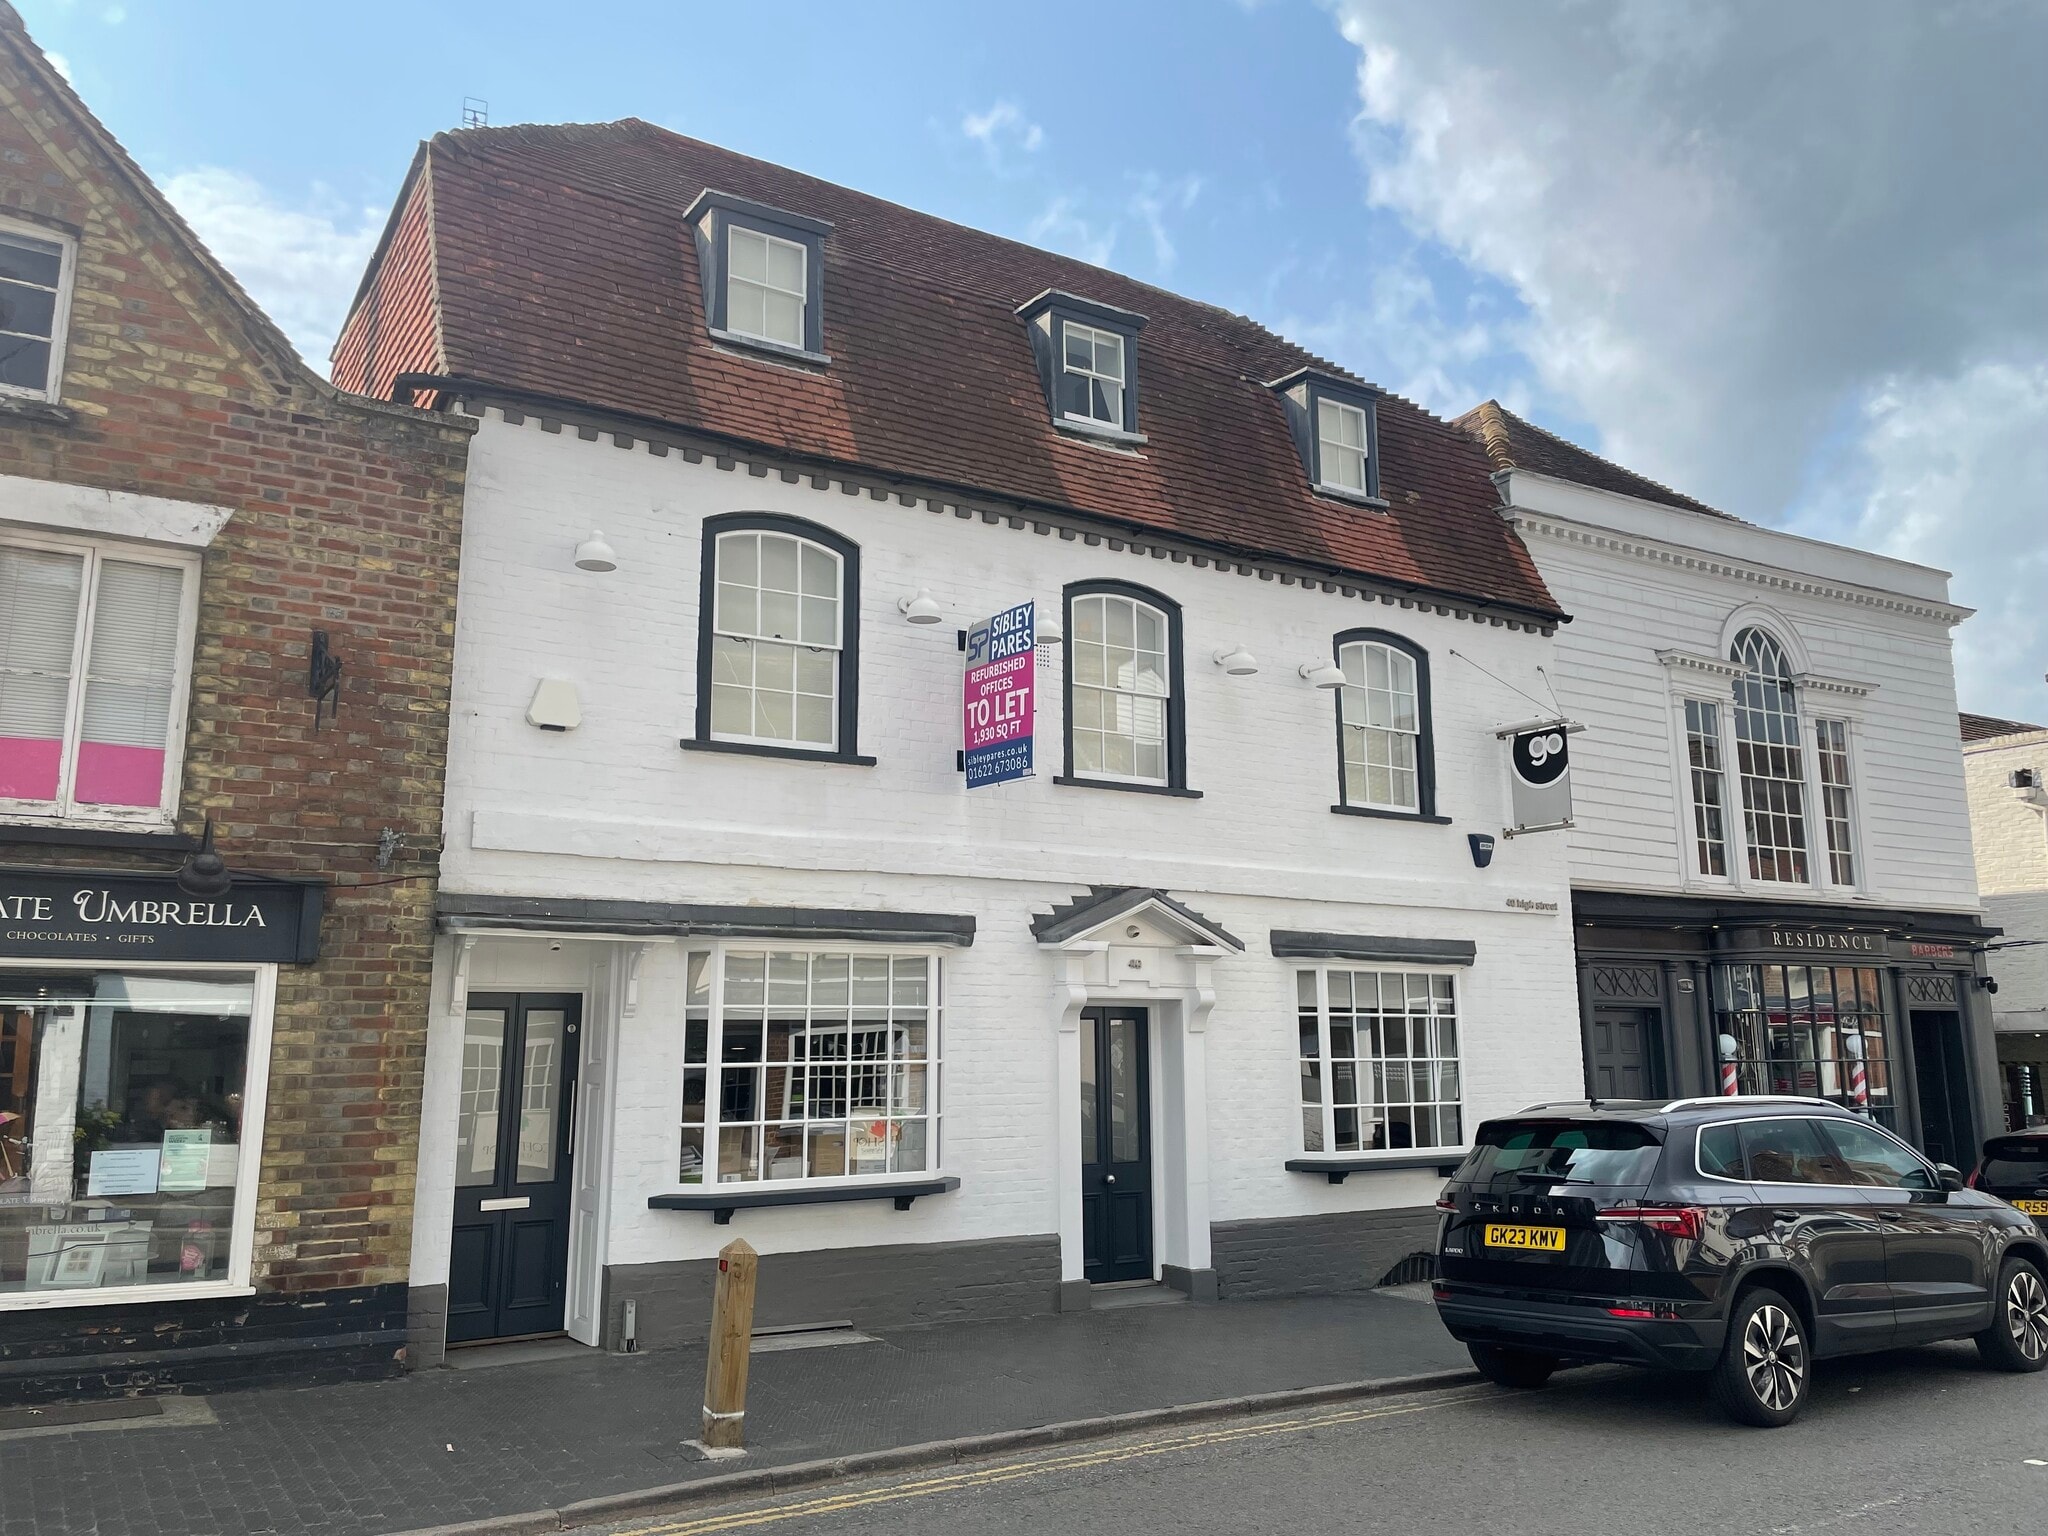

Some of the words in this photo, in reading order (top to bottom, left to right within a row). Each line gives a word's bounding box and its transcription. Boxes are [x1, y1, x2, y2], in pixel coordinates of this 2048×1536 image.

[992, 604, 1033, 637] SIBLEY
[991, 629, 1031, 660] PARES
[971, 656, 1026, 684] REFURBISHED
[980, 676, 1013, 696] OFFICES
[967, 698, 990, 729] TO
[995, 688, 1029, 722] LET
[973, 726, 995, 745] 1,930
[996, 723, 1008, 739] SQ
[1010, 720, 1021, 735] FT
[967, 743, 1028, 766] sibleypares.co.uk
[1528, 733, 1564, 767] go
[968, 763, 993, 780] 01622
[994, 756, 1028, 774] 673086
[73, 889, 266, 928] UMBRELLA
[6, 930, 98, 942] CHOCOLATES
[118, 933, 155, 944] GIFTS
[1772, 931, 1873, 950] RESIDENCE
[1911, 944, 1954, 958] BARBERS
[1490, 1227, 1526, 1245] GK23
[1529, 1229, 1559, 1248] KMV
